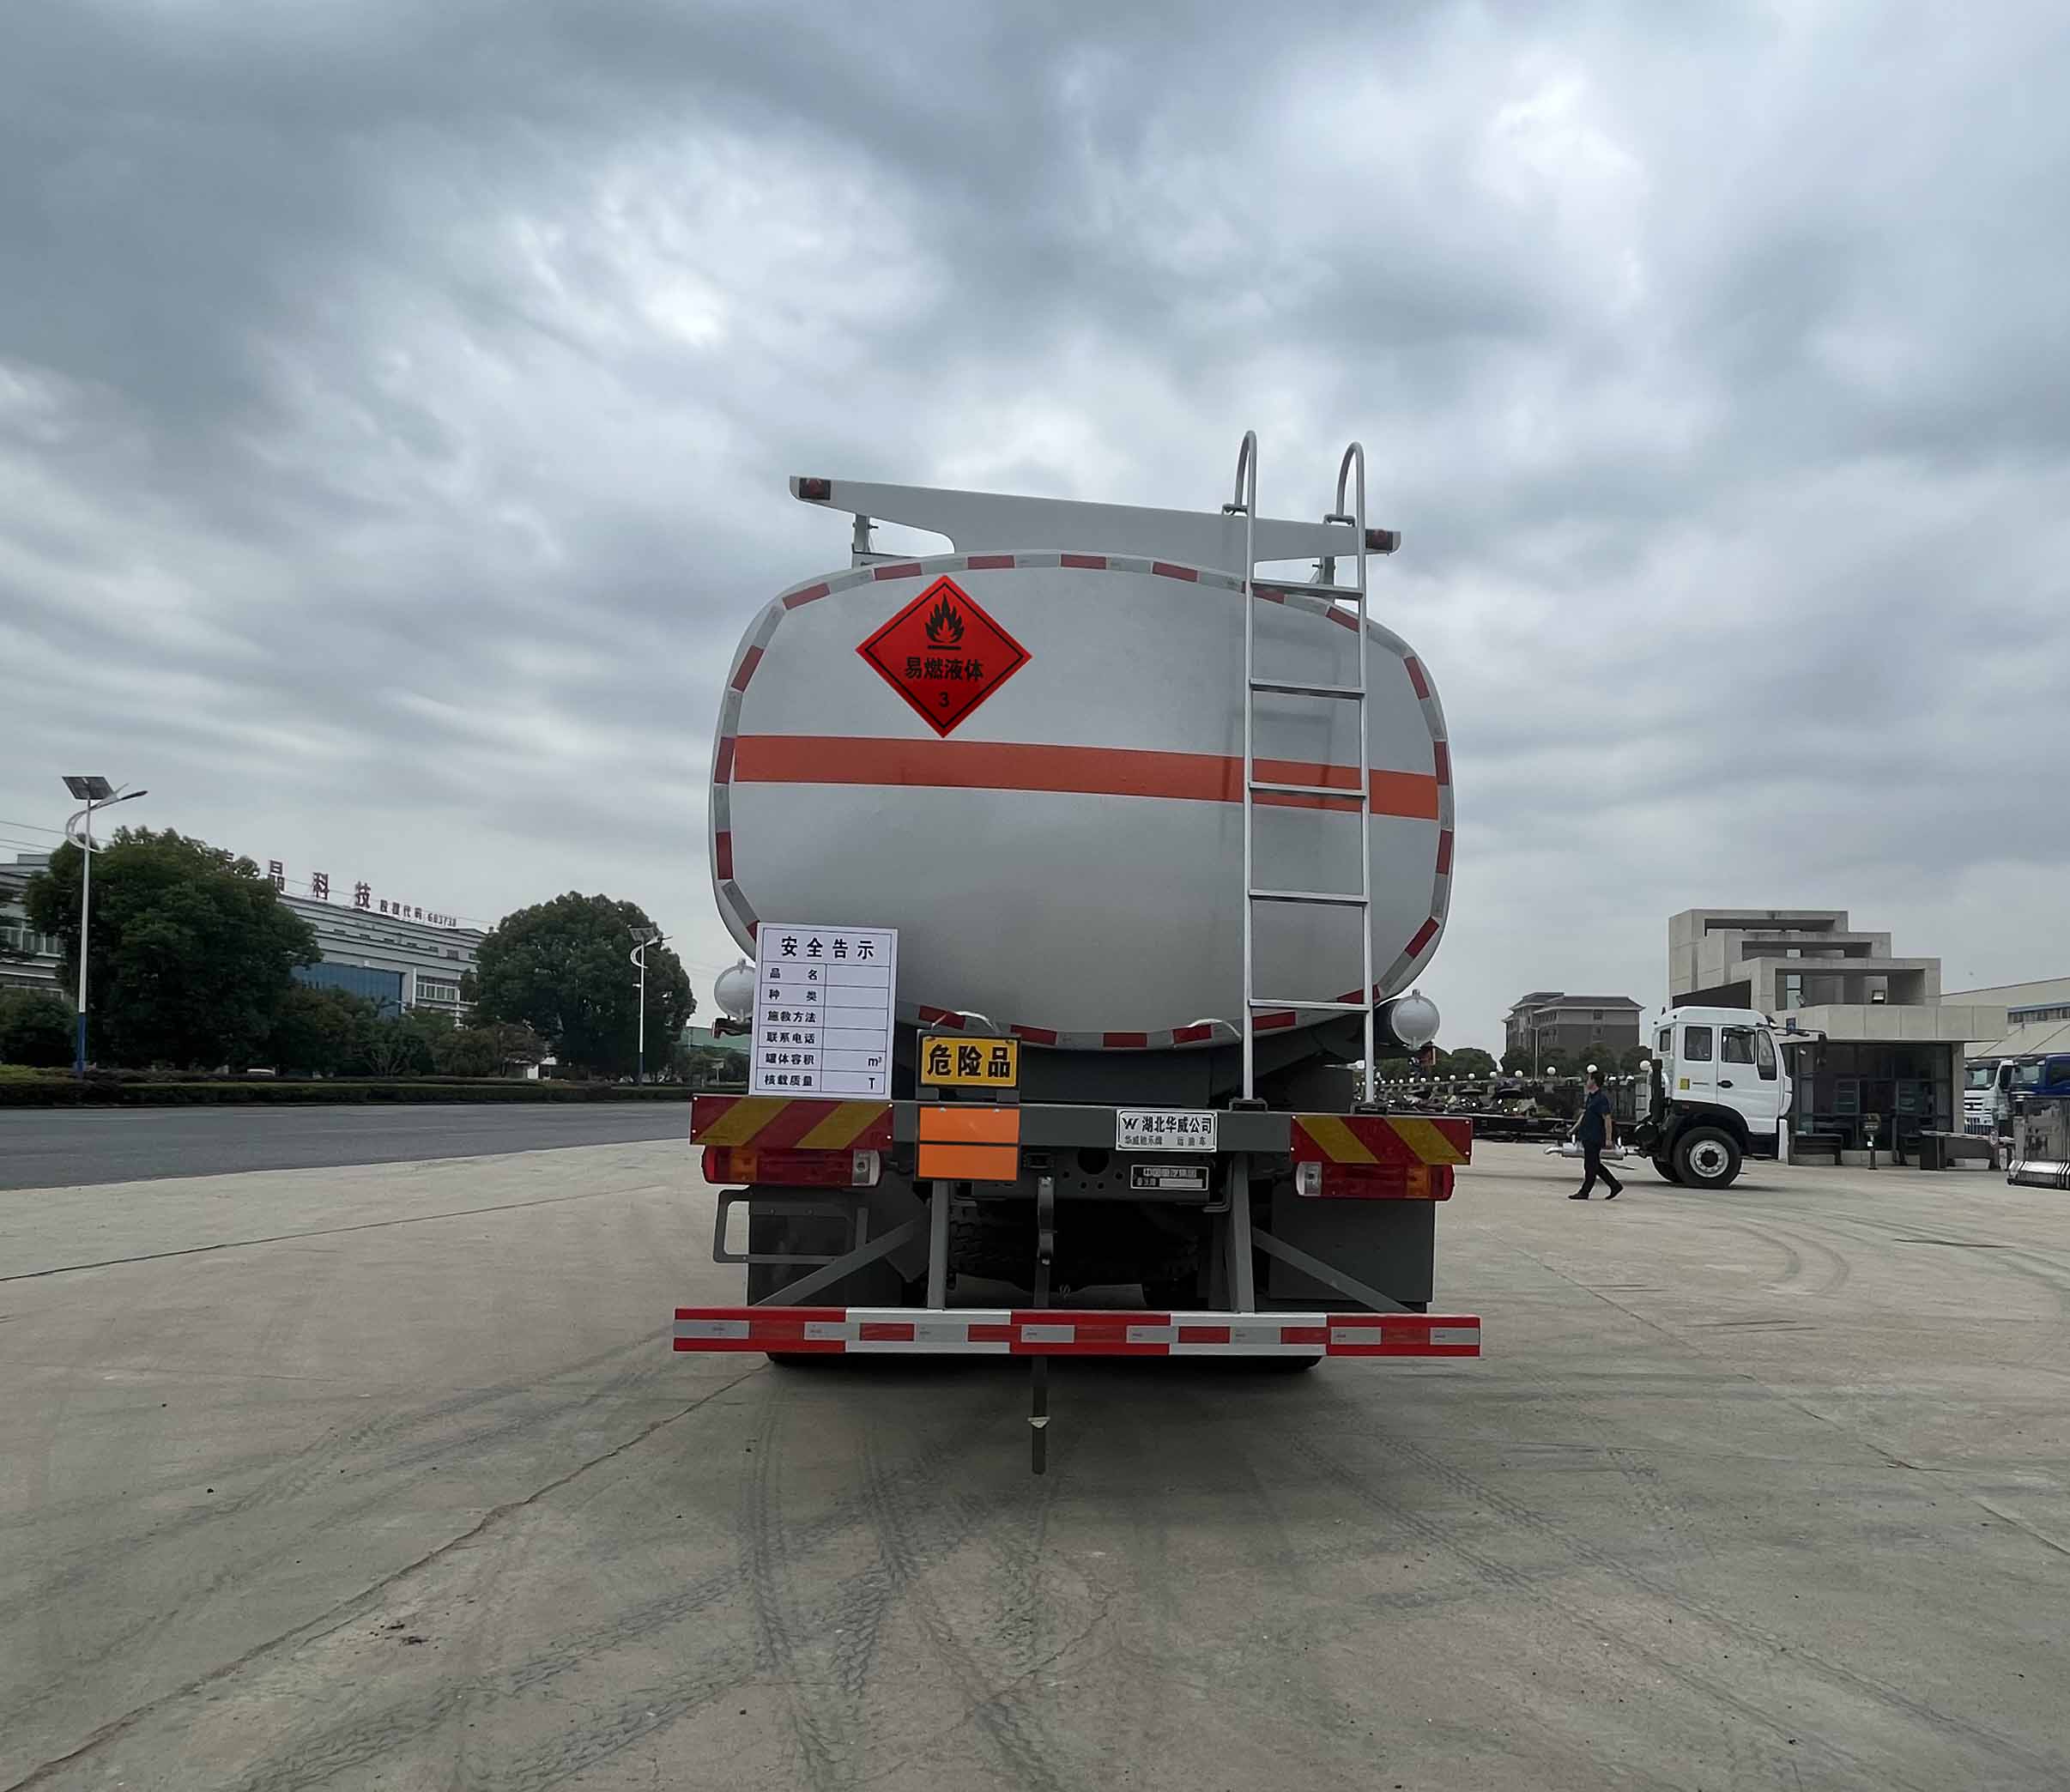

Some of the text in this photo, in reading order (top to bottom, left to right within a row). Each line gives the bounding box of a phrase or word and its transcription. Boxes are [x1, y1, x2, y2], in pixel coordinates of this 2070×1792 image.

[905, 656, 984, 682] 易燃液体
[938, 691, 950, 708] 3
[780, 935, 875, 960] 安全告示
[766, 1009, 817, 1024] 施救方法
[766, 1031, 816, 1044] 联系电话
[765, 1052, 814, 1066] 罐体容积
[926, 1043, 1012, 1079] 危险品
[764, 1074, 814, 1087] 核载质量
[868, 1077, 876, 1090] T
[1141, 1116, 1212, 1135] 湖北华威公司
